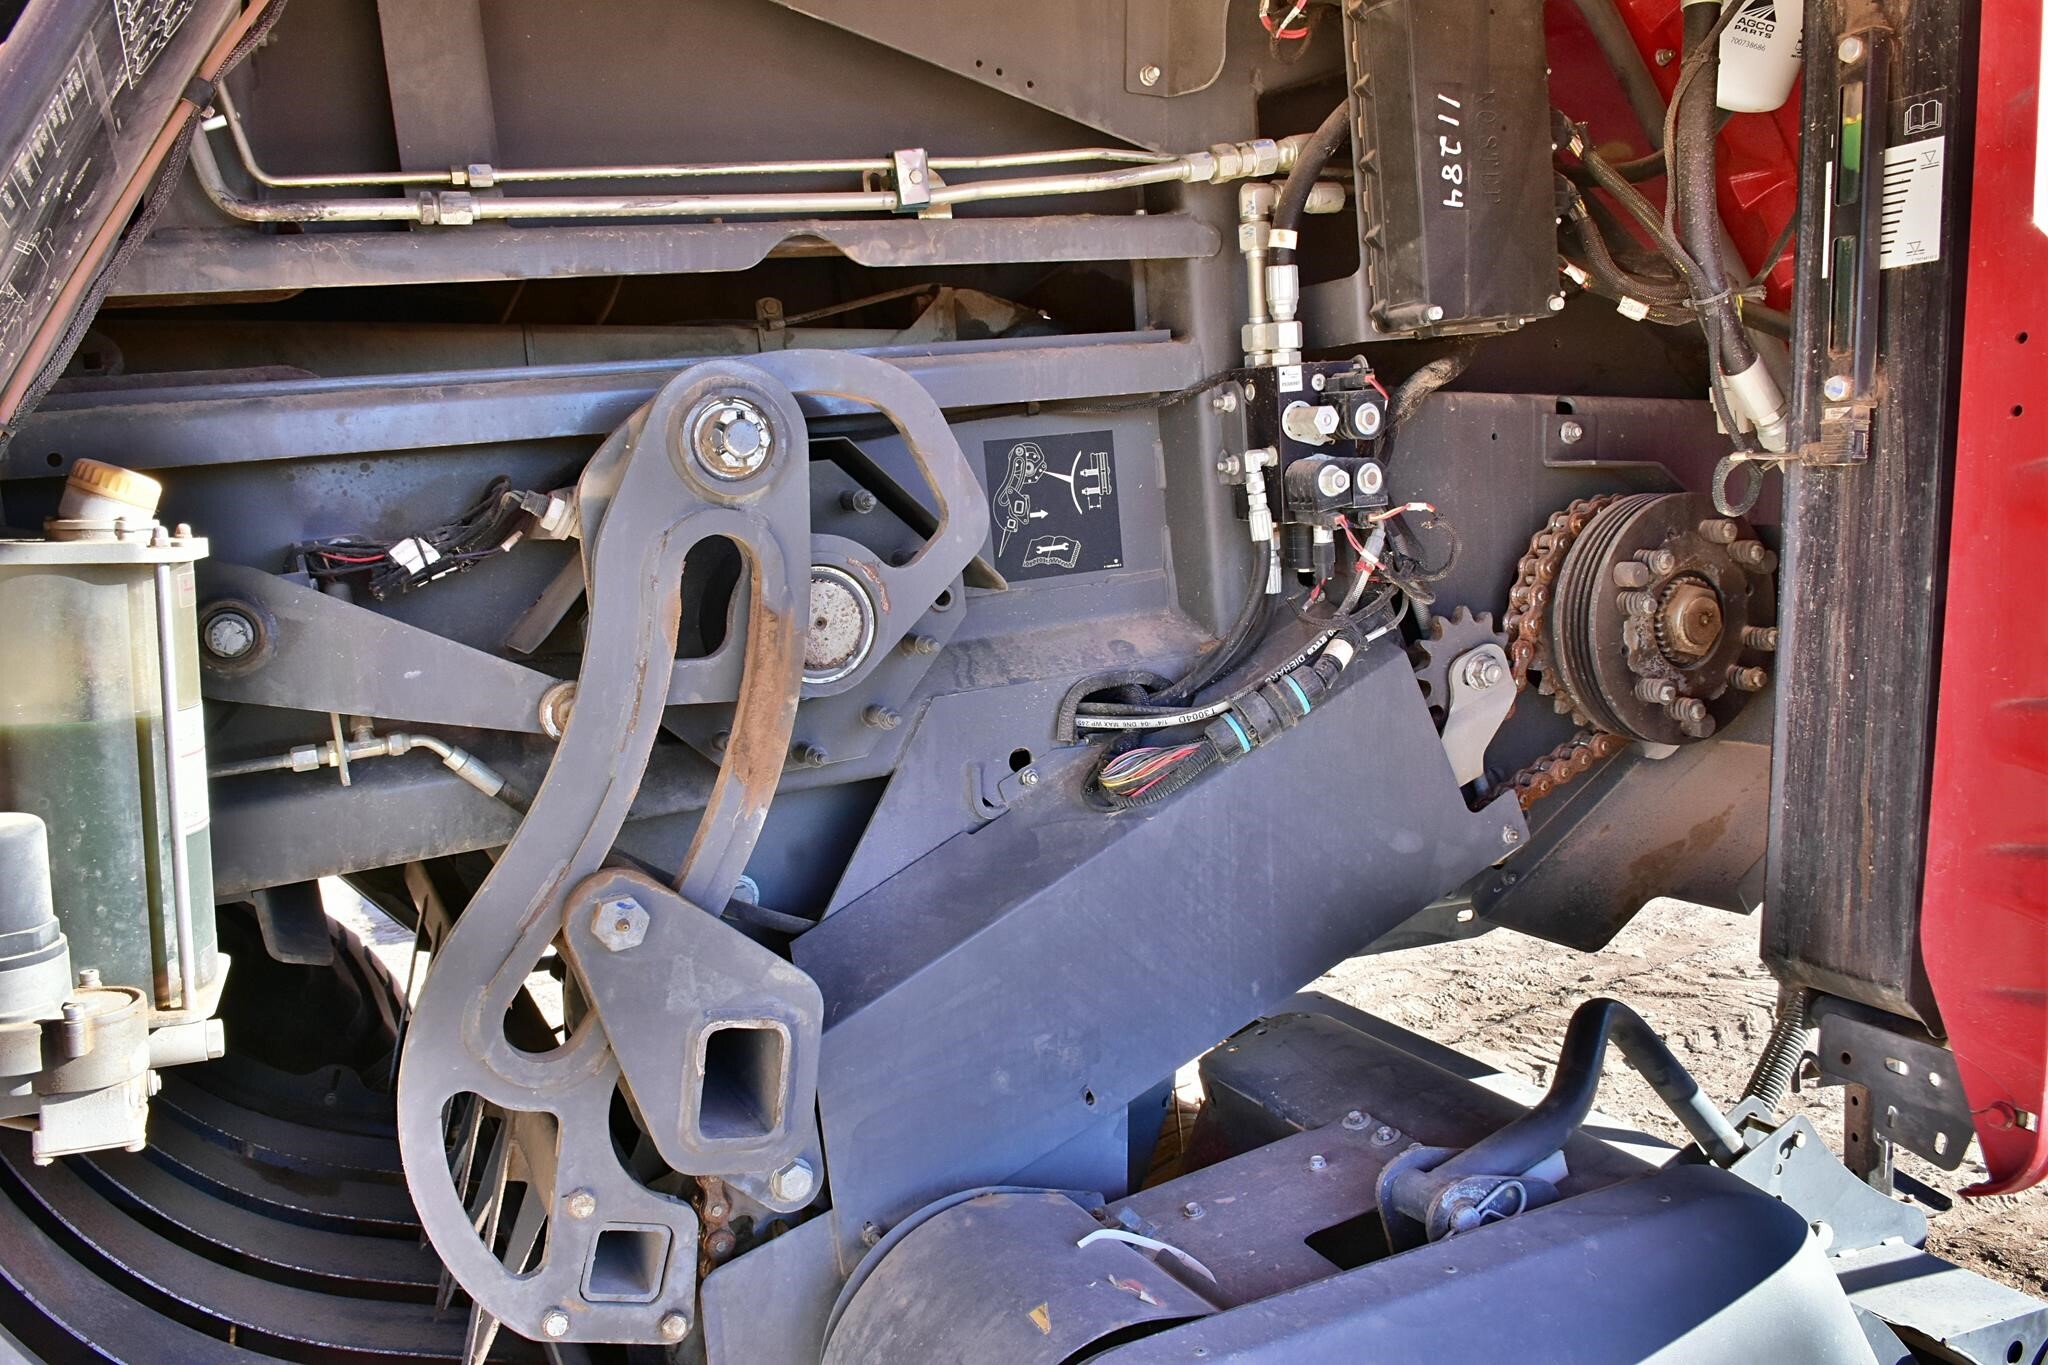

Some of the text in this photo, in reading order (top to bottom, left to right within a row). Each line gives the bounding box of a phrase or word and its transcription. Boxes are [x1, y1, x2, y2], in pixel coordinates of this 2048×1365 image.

[1734, 24, 1772, 39] PARTS
[1737, 16, 1775, 33] AGCO
[1437, 94, 1464, 208] 11284
[1178, 707, 1217, 723] T3004D
